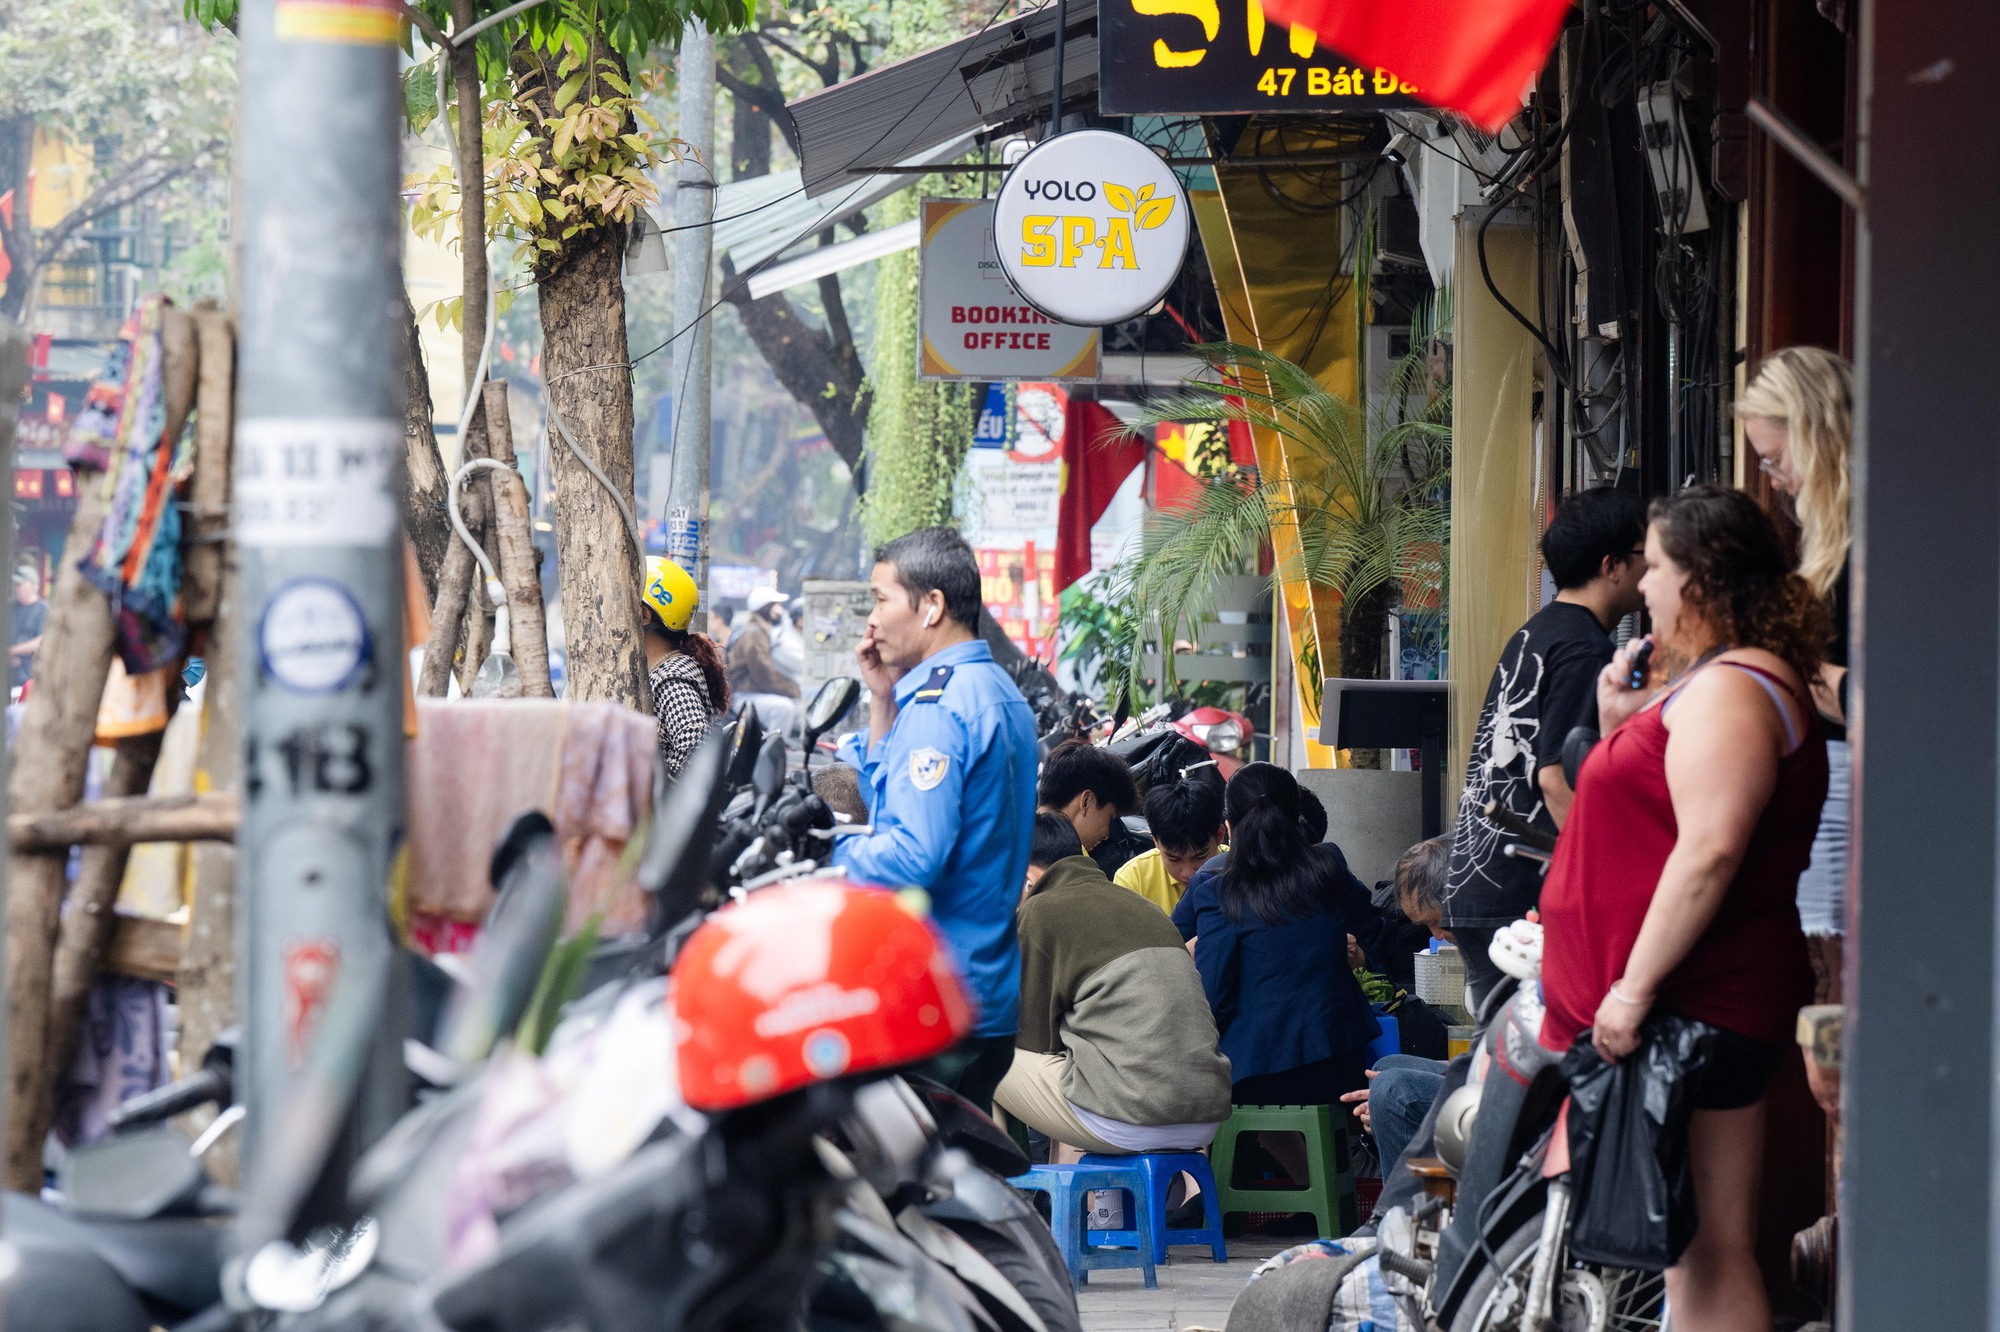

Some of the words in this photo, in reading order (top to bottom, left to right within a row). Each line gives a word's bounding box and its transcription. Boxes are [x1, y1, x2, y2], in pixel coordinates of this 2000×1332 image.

[1257, 68, 1296, 96] 47
[1307, 66, 1365, 96] Bát
[1024, 180, 1096, 202] YOLO
[1021, 215, 1141, 270] SPA
[951, 306, 1061, 325] BOOKIN
[963, 332, 1050, 350] OFFICE
[649, 577, 673, 607] be
